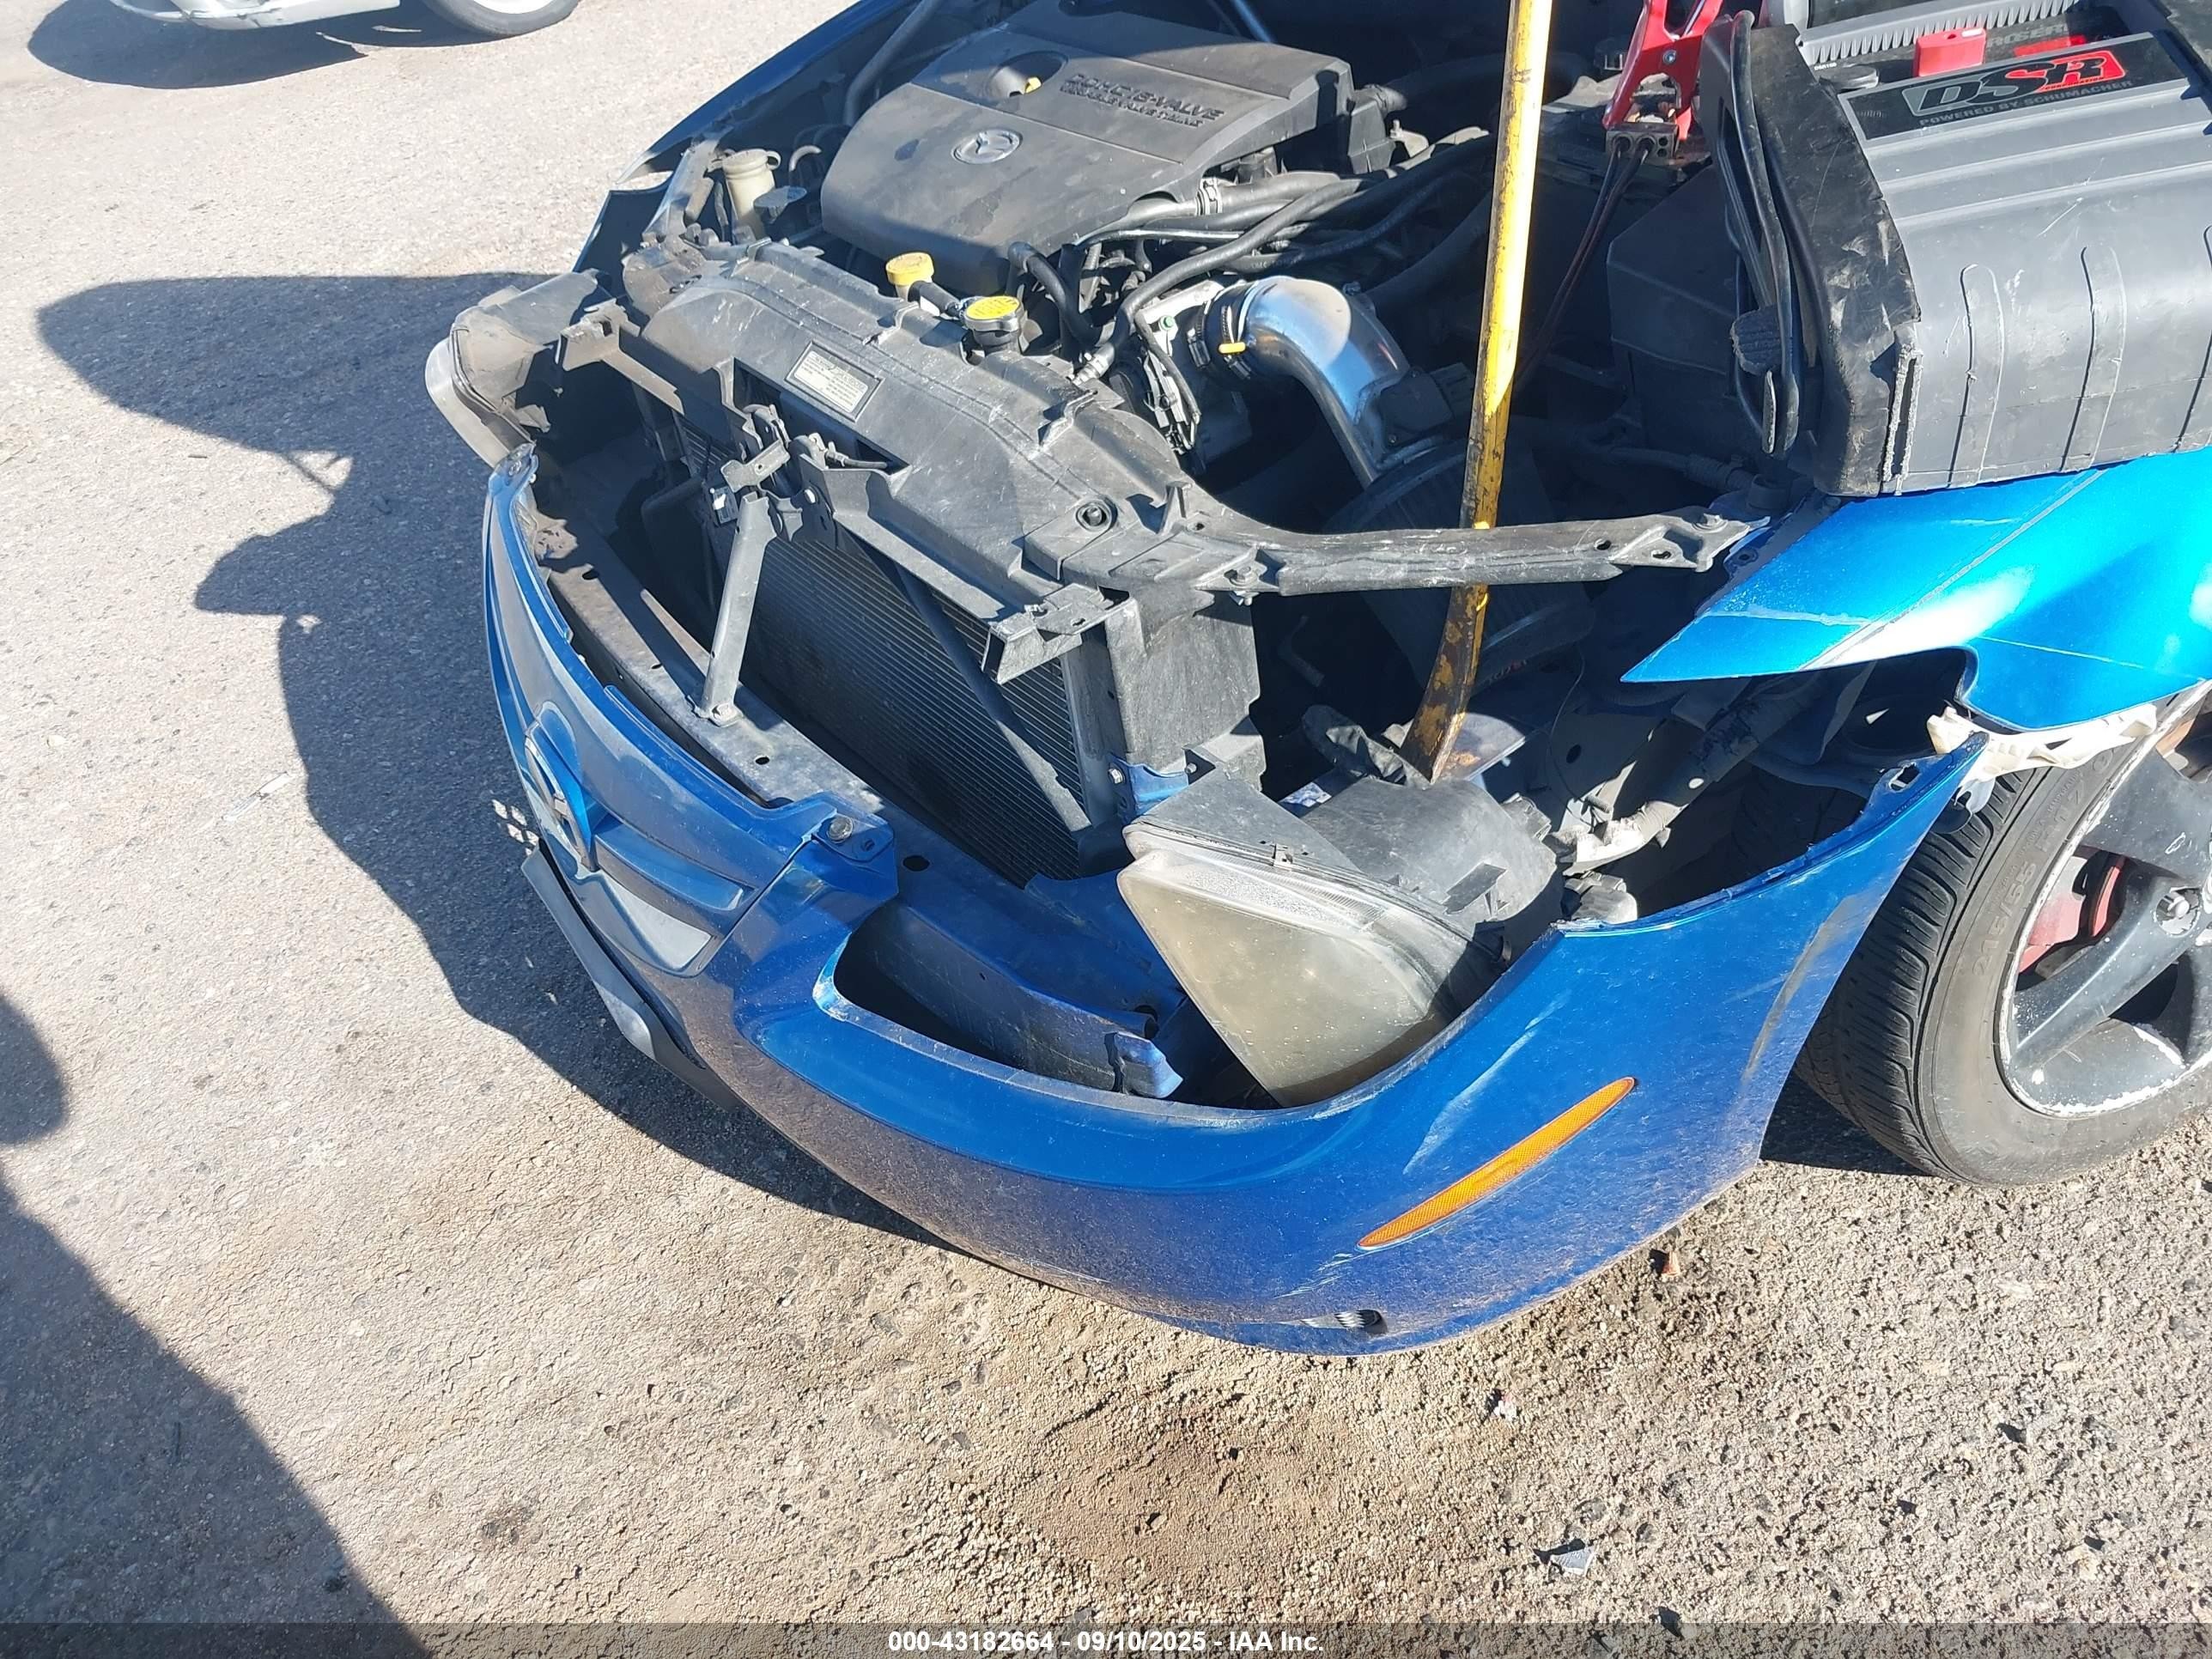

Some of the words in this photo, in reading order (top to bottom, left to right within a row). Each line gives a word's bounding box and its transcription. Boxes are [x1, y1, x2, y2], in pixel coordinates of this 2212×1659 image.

[1916, 54, 2108, 112] DSR
[1919, 105, 1994, 126] POWERED
[1997, 100, 2019, 112] BY
[2023, 80, 2135, 106] SCHUMACHER
[1972, 860, 2037, 975] 215/55
